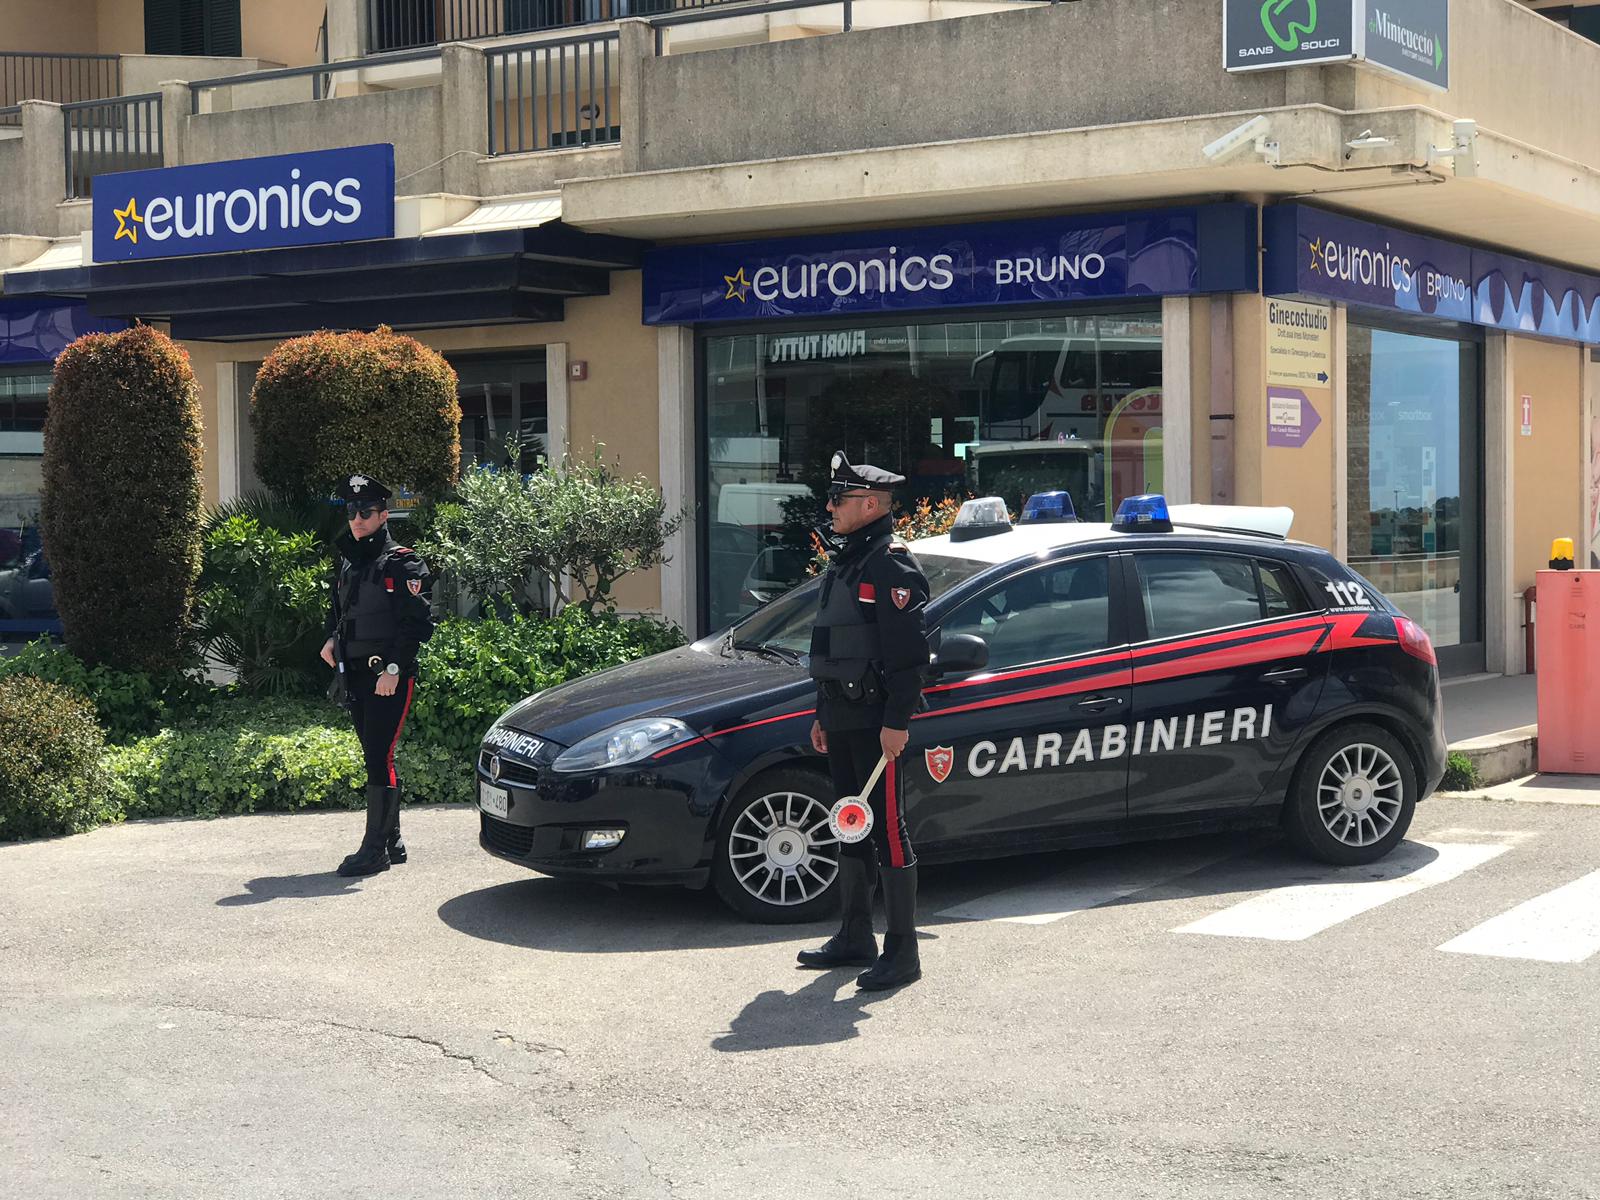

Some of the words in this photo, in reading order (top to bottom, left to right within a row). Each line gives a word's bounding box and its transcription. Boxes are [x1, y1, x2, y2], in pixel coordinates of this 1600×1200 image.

[1238, 46, 1274, 57] SANS
[1301, 38, 1340, 51] SOUCI
[1375, 8, 1433, 57] Minicuccio
[144, 168, 362, 241] euronics
[753, 246, 954, 301] euronics
[996, 253, 1105, 285] BRUNO
[1324, 240, 1411, 293] euronics
[1427, 271, 1465, 301] BRUNO
[1269, 302, 1328, 330] Ginecostudio
[1325, 581, 1371, 606] 112
[967, 703, 1273, 778] CARABINIERI
